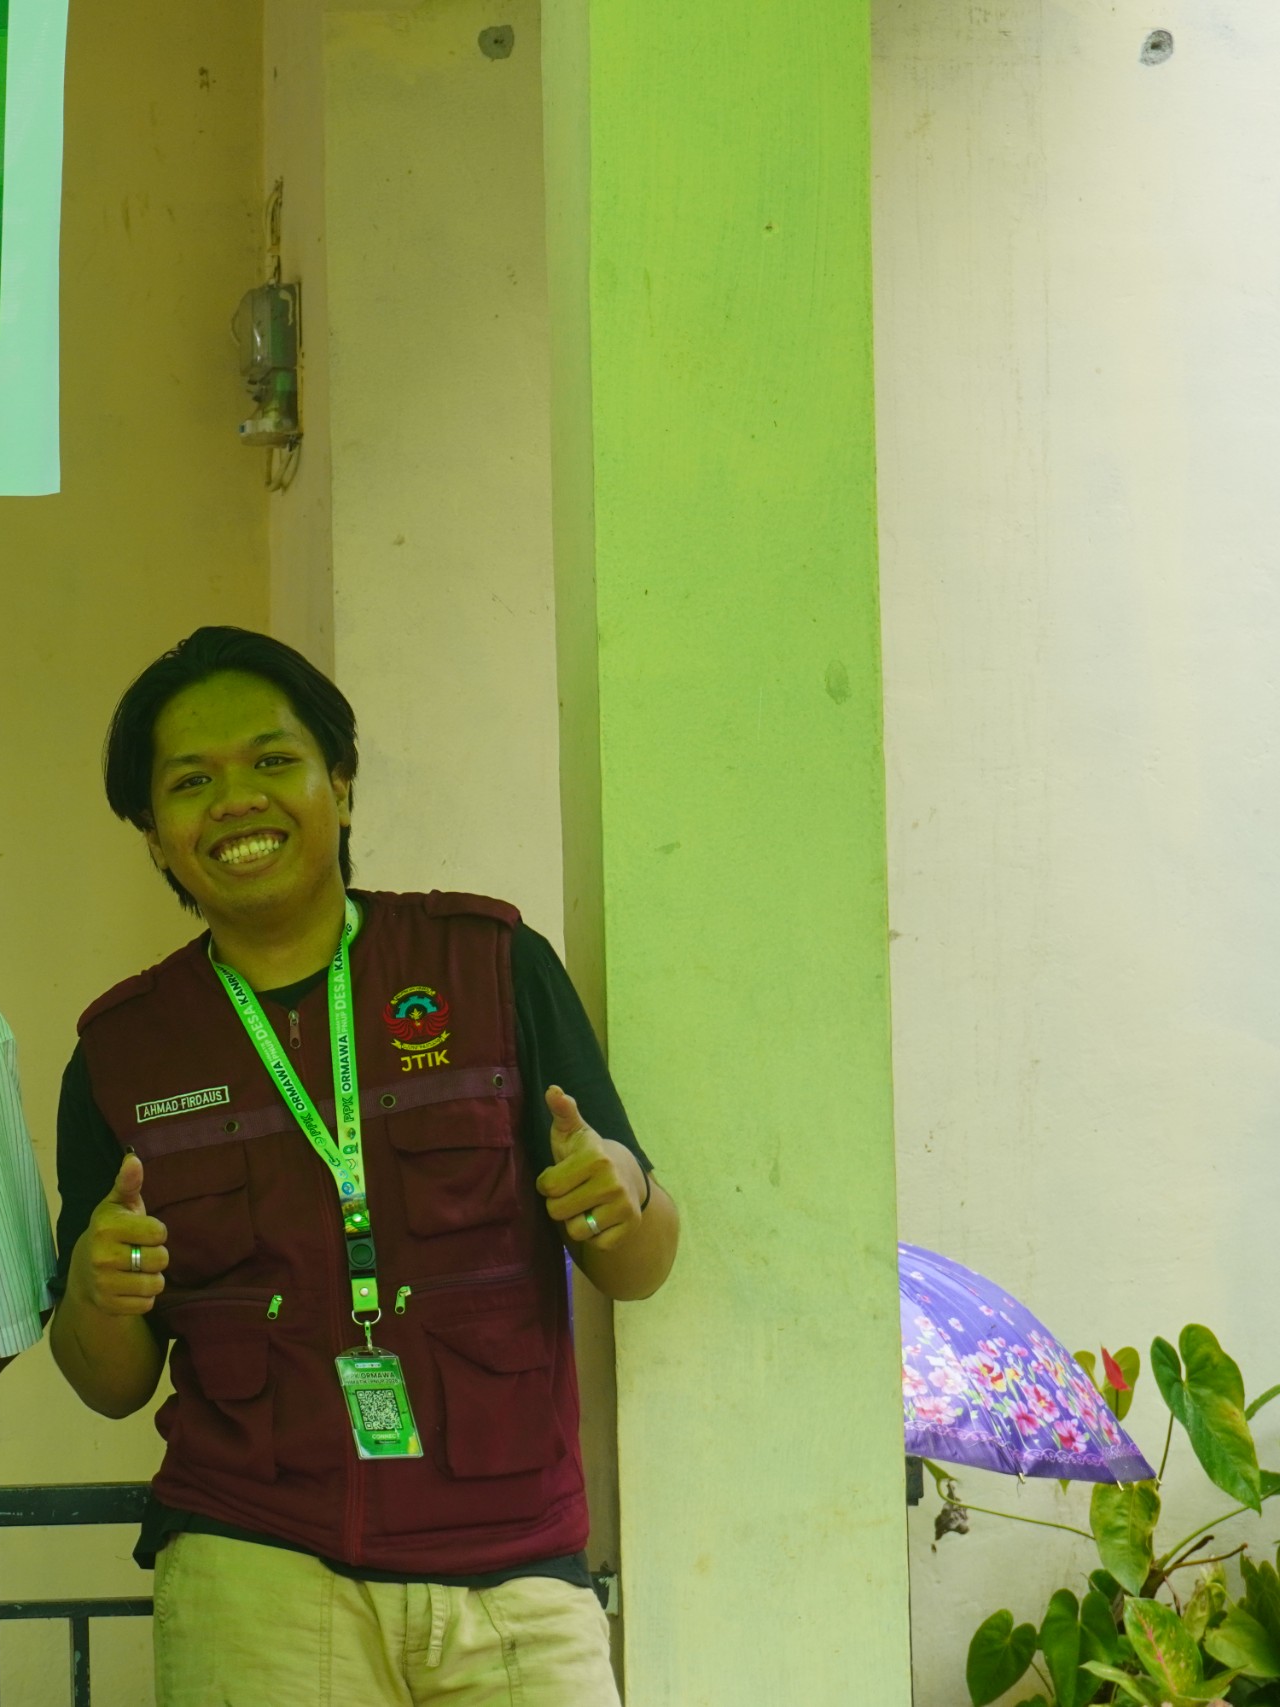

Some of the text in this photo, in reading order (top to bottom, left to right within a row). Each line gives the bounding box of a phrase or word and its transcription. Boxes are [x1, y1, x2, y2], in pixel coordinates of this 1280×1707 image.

[333, 973, 347, 1010] DESA
[243, 1004, 269, 1041] DESA
[338, 1034, 355, 1123] PPK ORMAWA
[400, 1049, 451, 1072] JTIK
[143, 1090, 223, 1118] AHMAD FIRDAUS
[272, 1060, 322, 1137] PPK ORMAWA
[360, 1371, 396, 1379] ORMAWA
